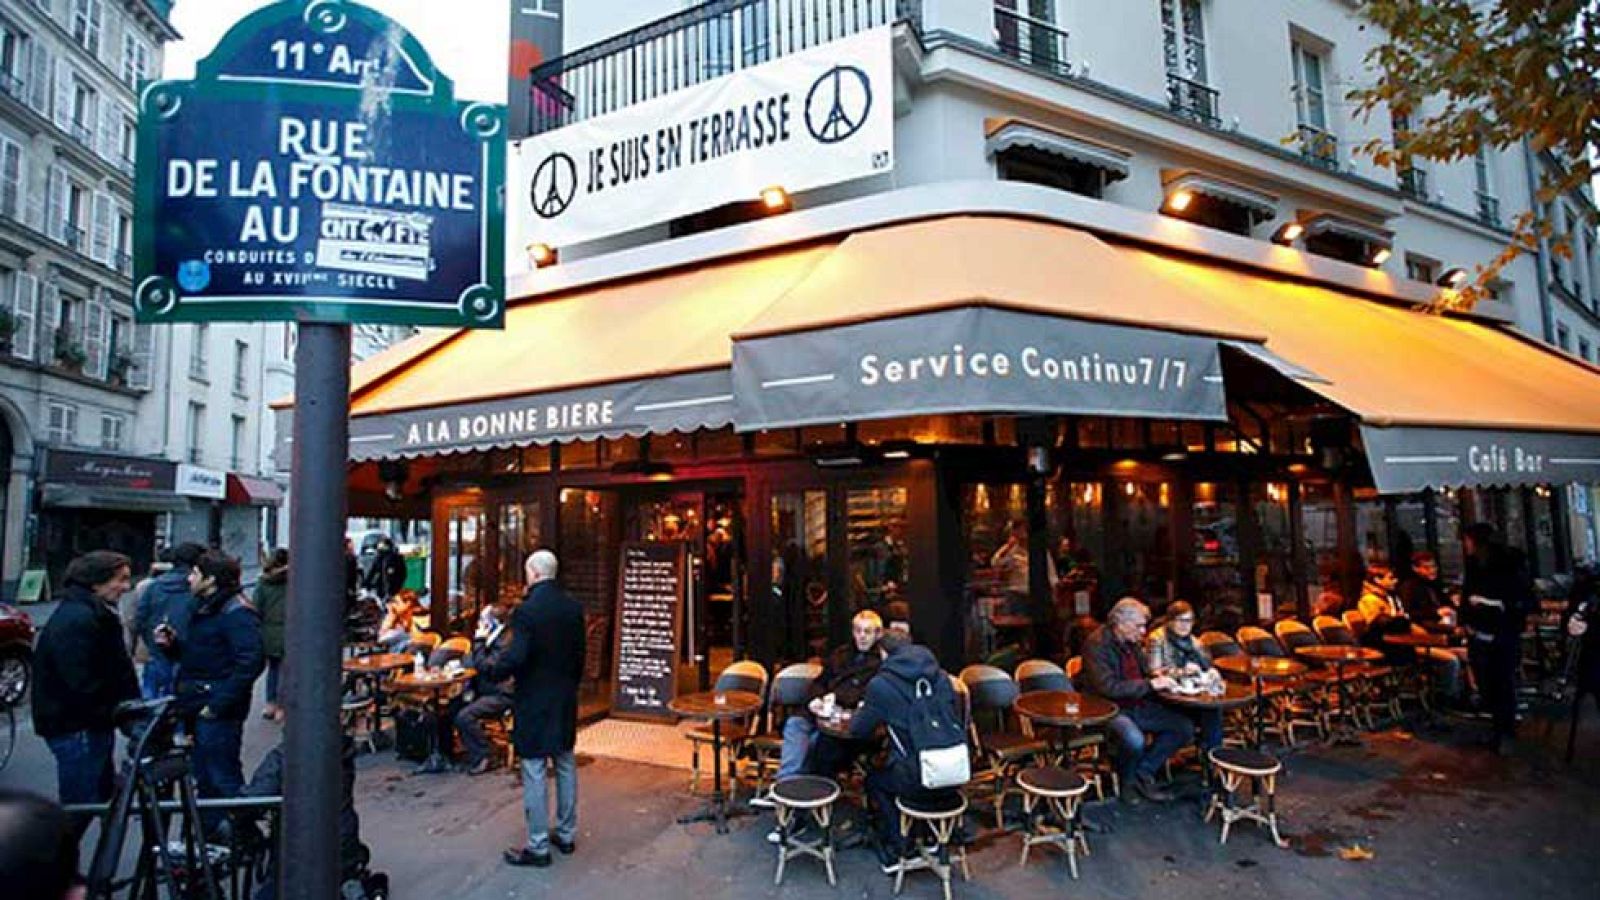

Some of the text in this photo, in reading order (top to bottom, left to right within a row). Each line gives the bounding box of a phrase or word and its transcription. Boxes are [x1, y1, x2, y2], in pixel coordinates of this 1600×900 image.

[280, 117, 367, 158] RUE
[586, 92, 790, 193] JE SUIS EN TERRASSE
[167, 159, 474, 210] DE LA FONTAINE
[239, 205, 300, 243] AU
[203, 249, 297, 264] CONDUITES
[243, 271, 265, 285] AU
[859, 344, 1010, 386] Service
[406, 399, 614, 446] A LA BONNE BIERE
[1468, 444, 1543, 473] Café Bar
